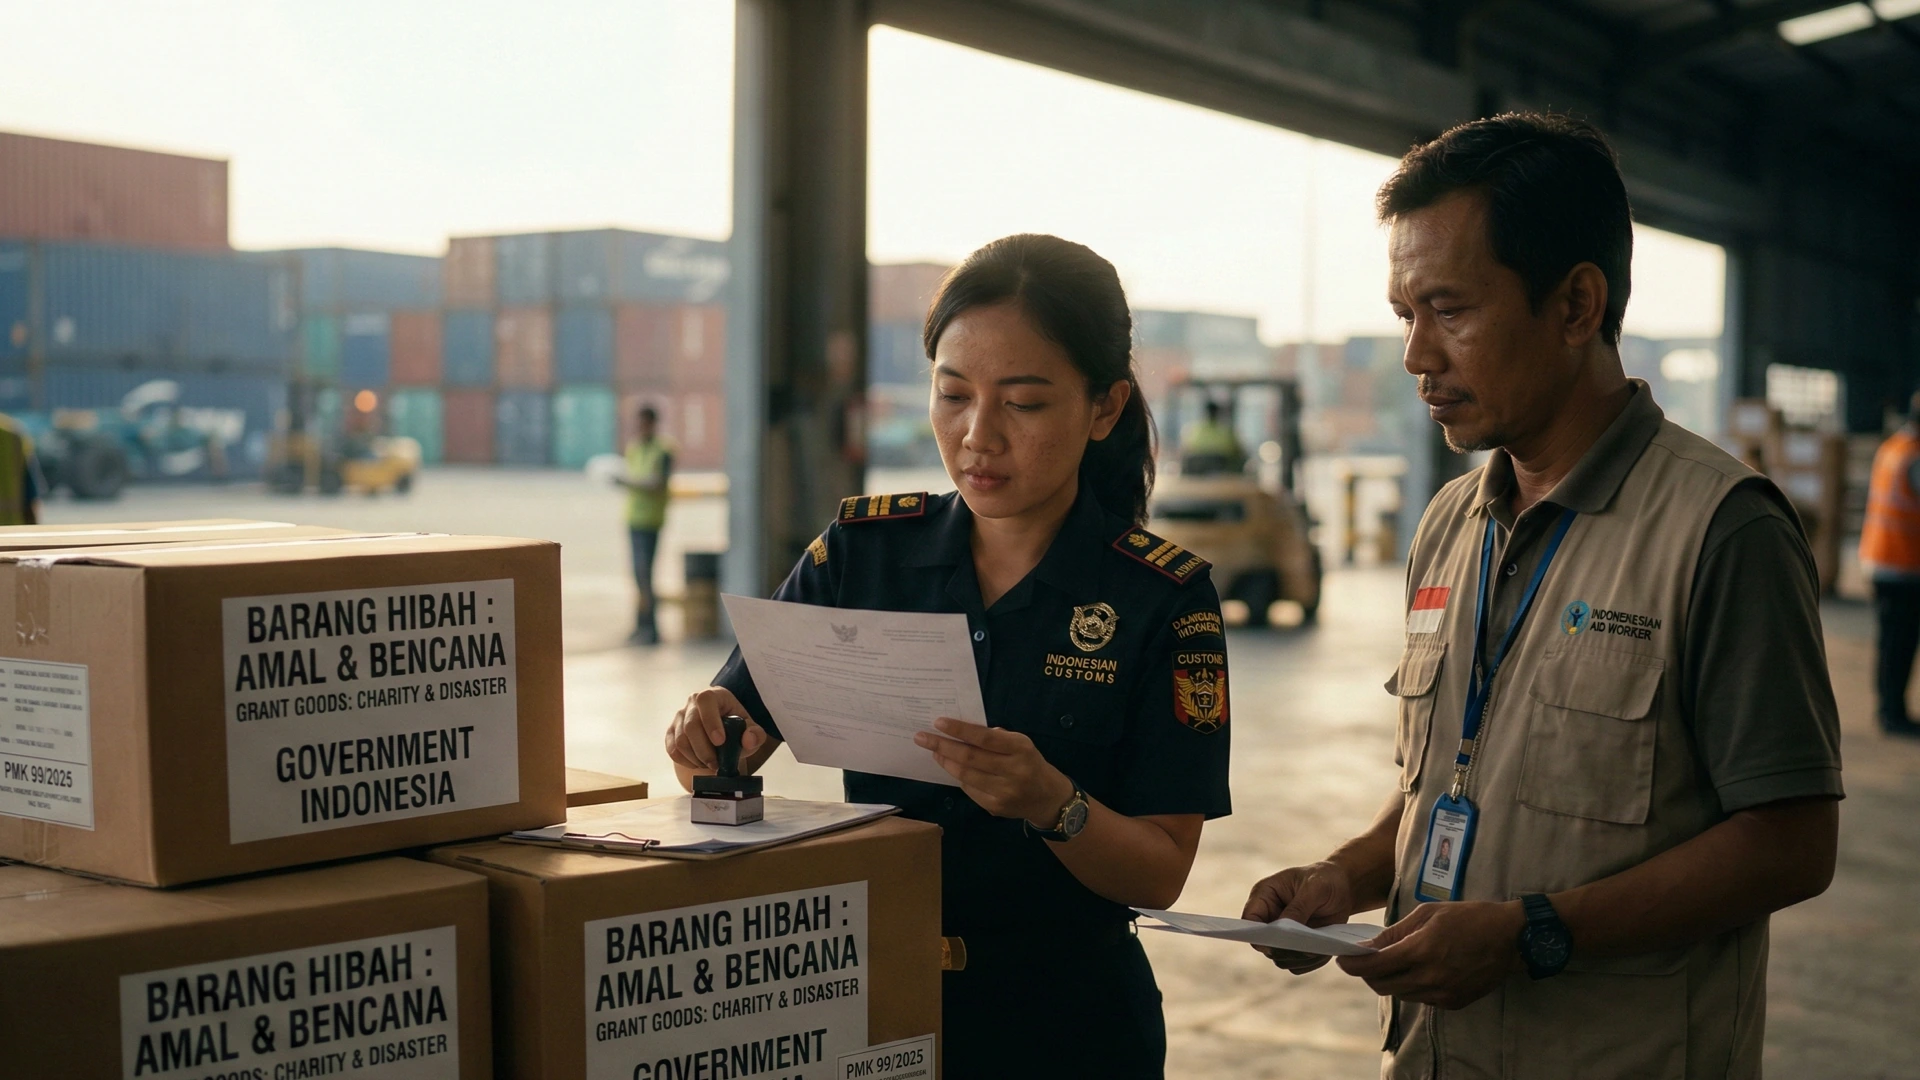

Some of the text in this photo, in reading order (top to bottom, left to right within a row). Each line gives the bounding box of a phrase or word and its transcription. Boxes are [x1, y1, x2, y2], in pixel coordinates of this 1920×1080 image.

[247, 597, 377, 644] BARANG
[387, 590, 476, 631] HIBAH
[1590, 622, 1651, 640] AID WORKER
[235, 632, 506, 692] AMAL & BENCANA
[1044, 665, 1115, 684] CUSTOMS
[1046, 653, 1117, 672] INDONESIAN
[236, 676, 507, 722] GRANT GOODS: CHARITY & DISASTER
[4, 761, 73, 788] PMK 99/2025
[276, 725, 475, 783] GOVERNMENT
[301, 770, 456, 824] INDONESIA
[605, 910, 733, 965] BARANG
[742, 894, 831, 942] HIBAH
[147, 961, 296, 1023] BARANG
[309, 942, 413, 997] HIBAH
[594, 933, 860, 1012] AMAL & BENCANA
[134, 985, 448, 1077] AMAL & BENCANA
[595, 977, 860, 1042] GRANT GOODS: CHARITY & DISASTER
[274, 1052, 347, 1080] CHARITY
[352, 1049, 364, 1069] &
[369, 1034, 448, 1066] DISASTER
[846, 1059, 874, 1079] PMK
[876, 1049, 924, 1073] 99/2025
